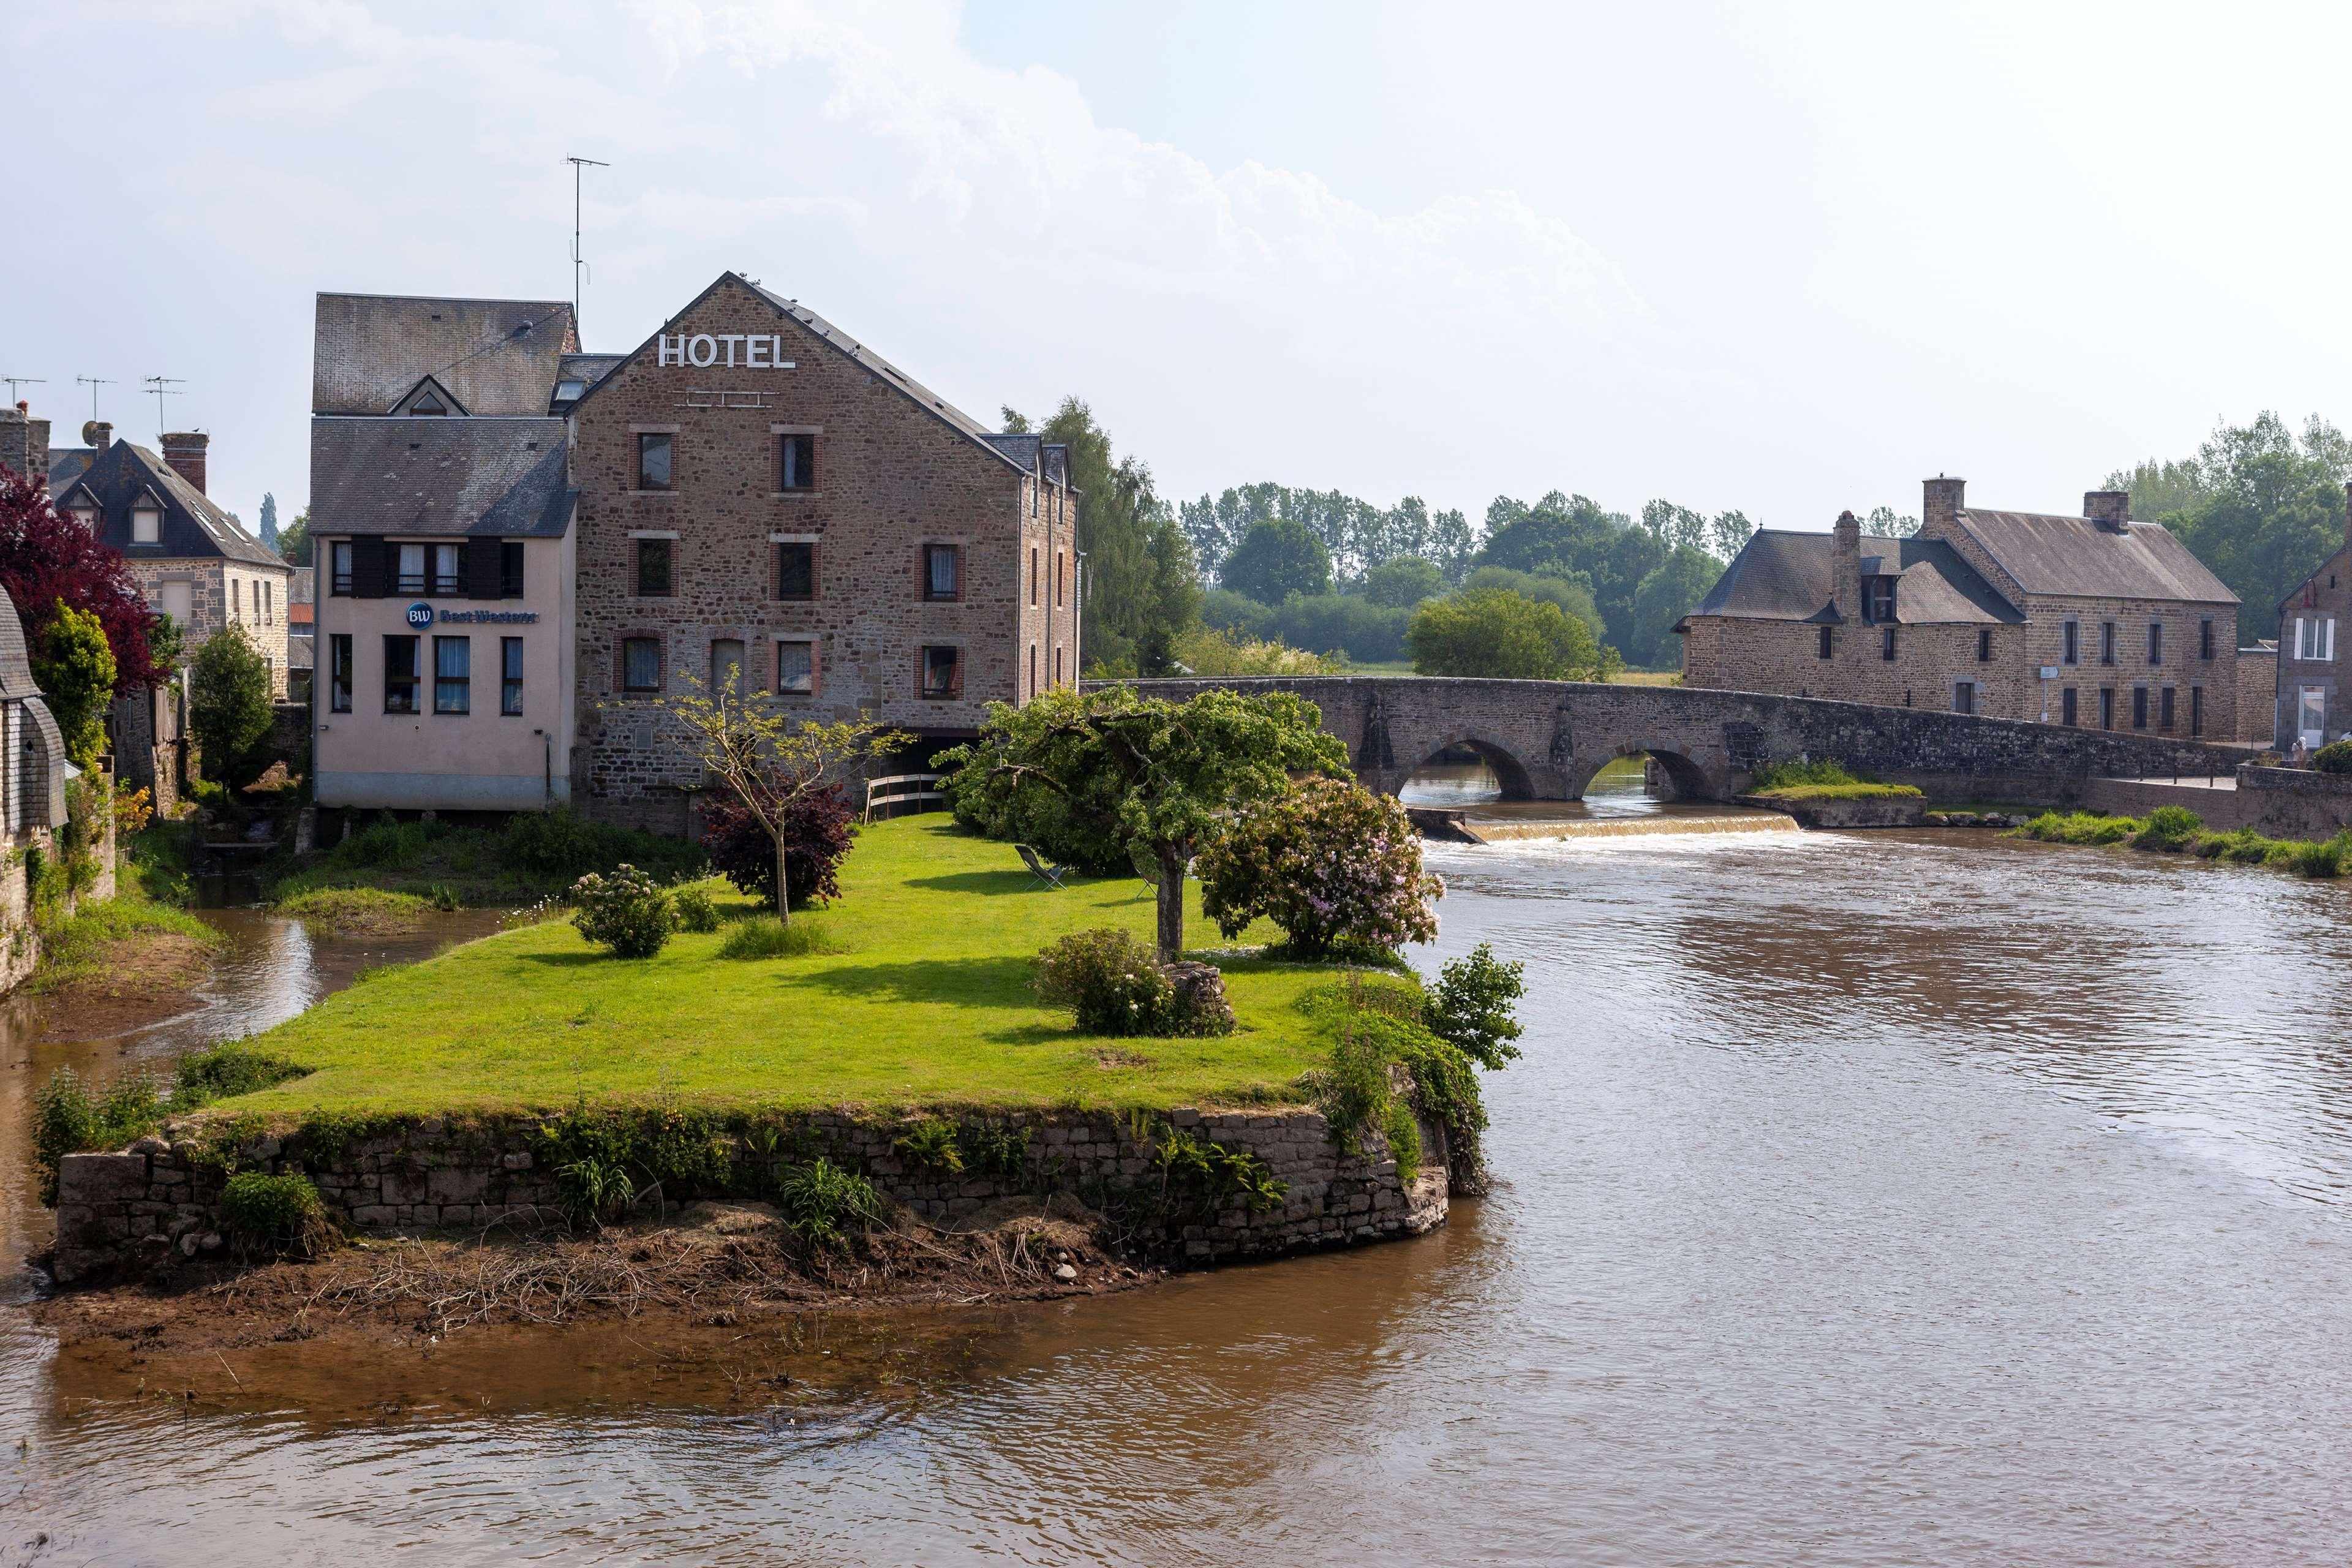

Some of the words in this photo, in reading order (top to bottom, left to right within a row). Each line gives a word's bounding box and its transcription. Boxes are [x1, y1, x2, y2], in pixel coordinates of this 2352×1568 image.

[658, 334, 796, 368] HOTEL
[409, 611, 430, 622] BW
[440, 610, 471, 623] Best
[475, 610, 536, 624] Western
